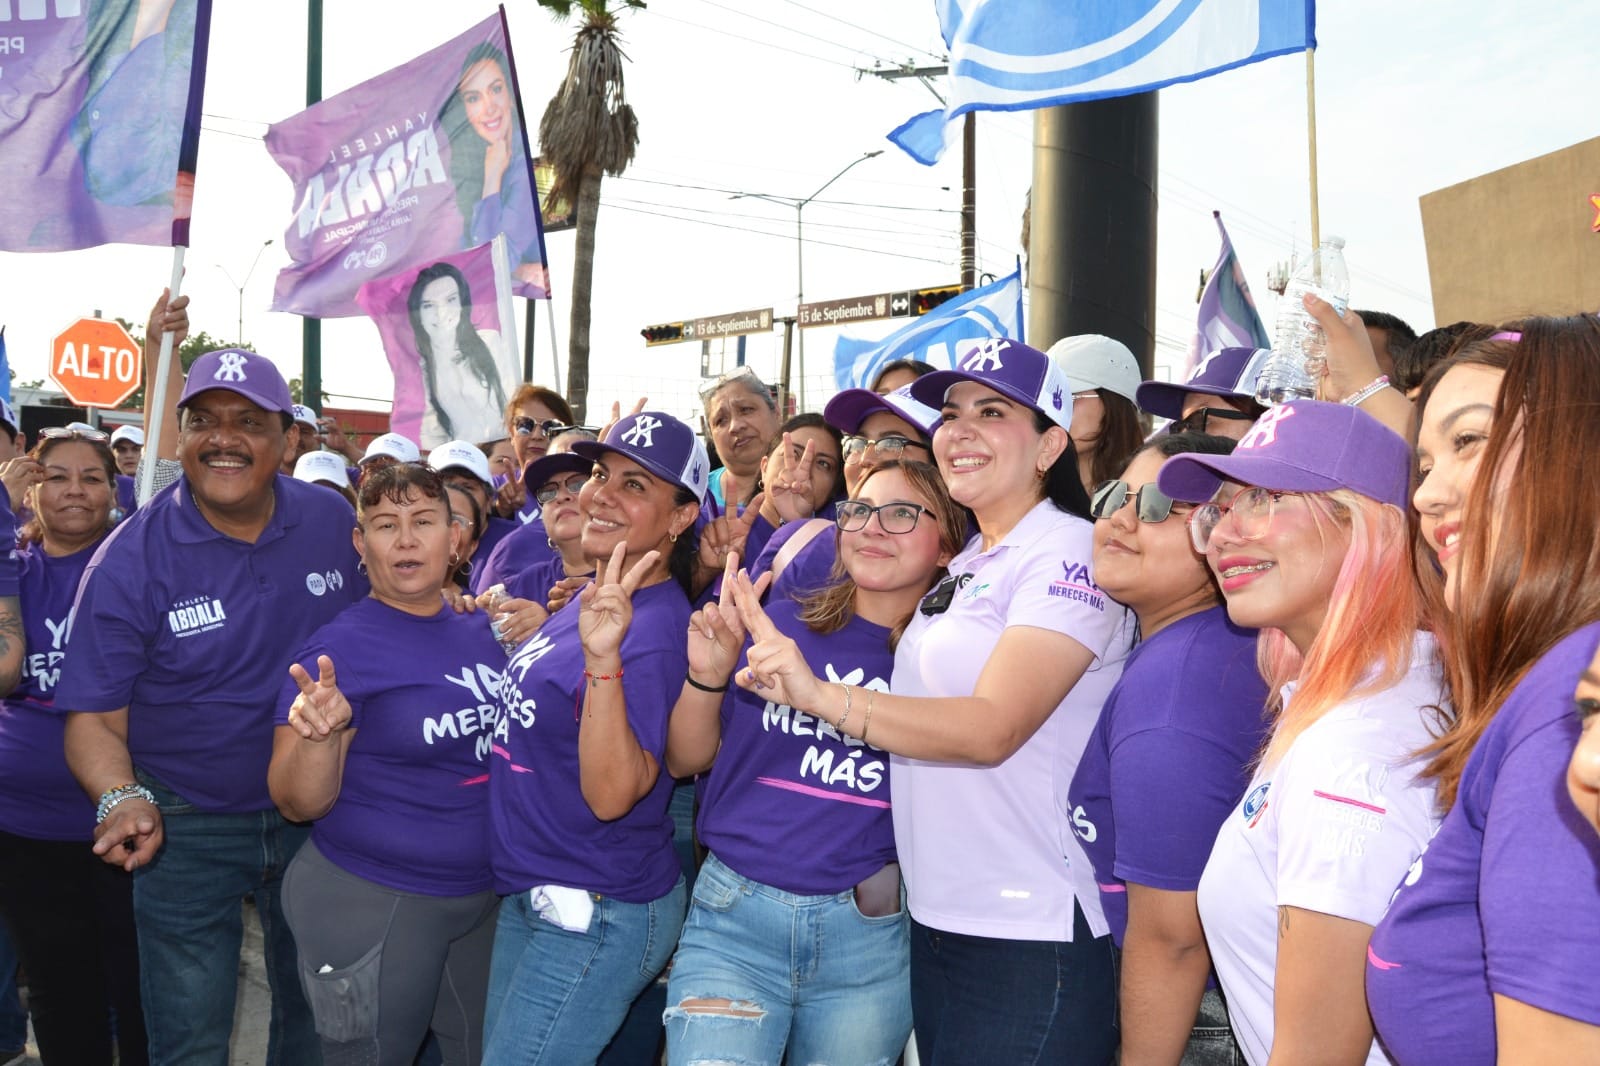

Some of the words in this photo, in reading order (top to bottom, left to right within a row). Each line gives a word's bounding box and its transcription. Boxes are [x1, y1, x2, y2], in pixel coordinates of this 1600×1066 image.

[697, 324, 706, 335] 15
[706, 322, 717, 334] de
[717, 316, 759, 335] Septiembre
[800, 310, 810, 324] 15
[811, 307, 822, 322] de
[823, 302, 873, 325] Septiembre
[57, 341, 135, 383] ALTO
[1047, 585, 1089, 604] MERECES
[168, 599, 227, 633] ABDALA
[800, 745, 885, 792] MÁS
